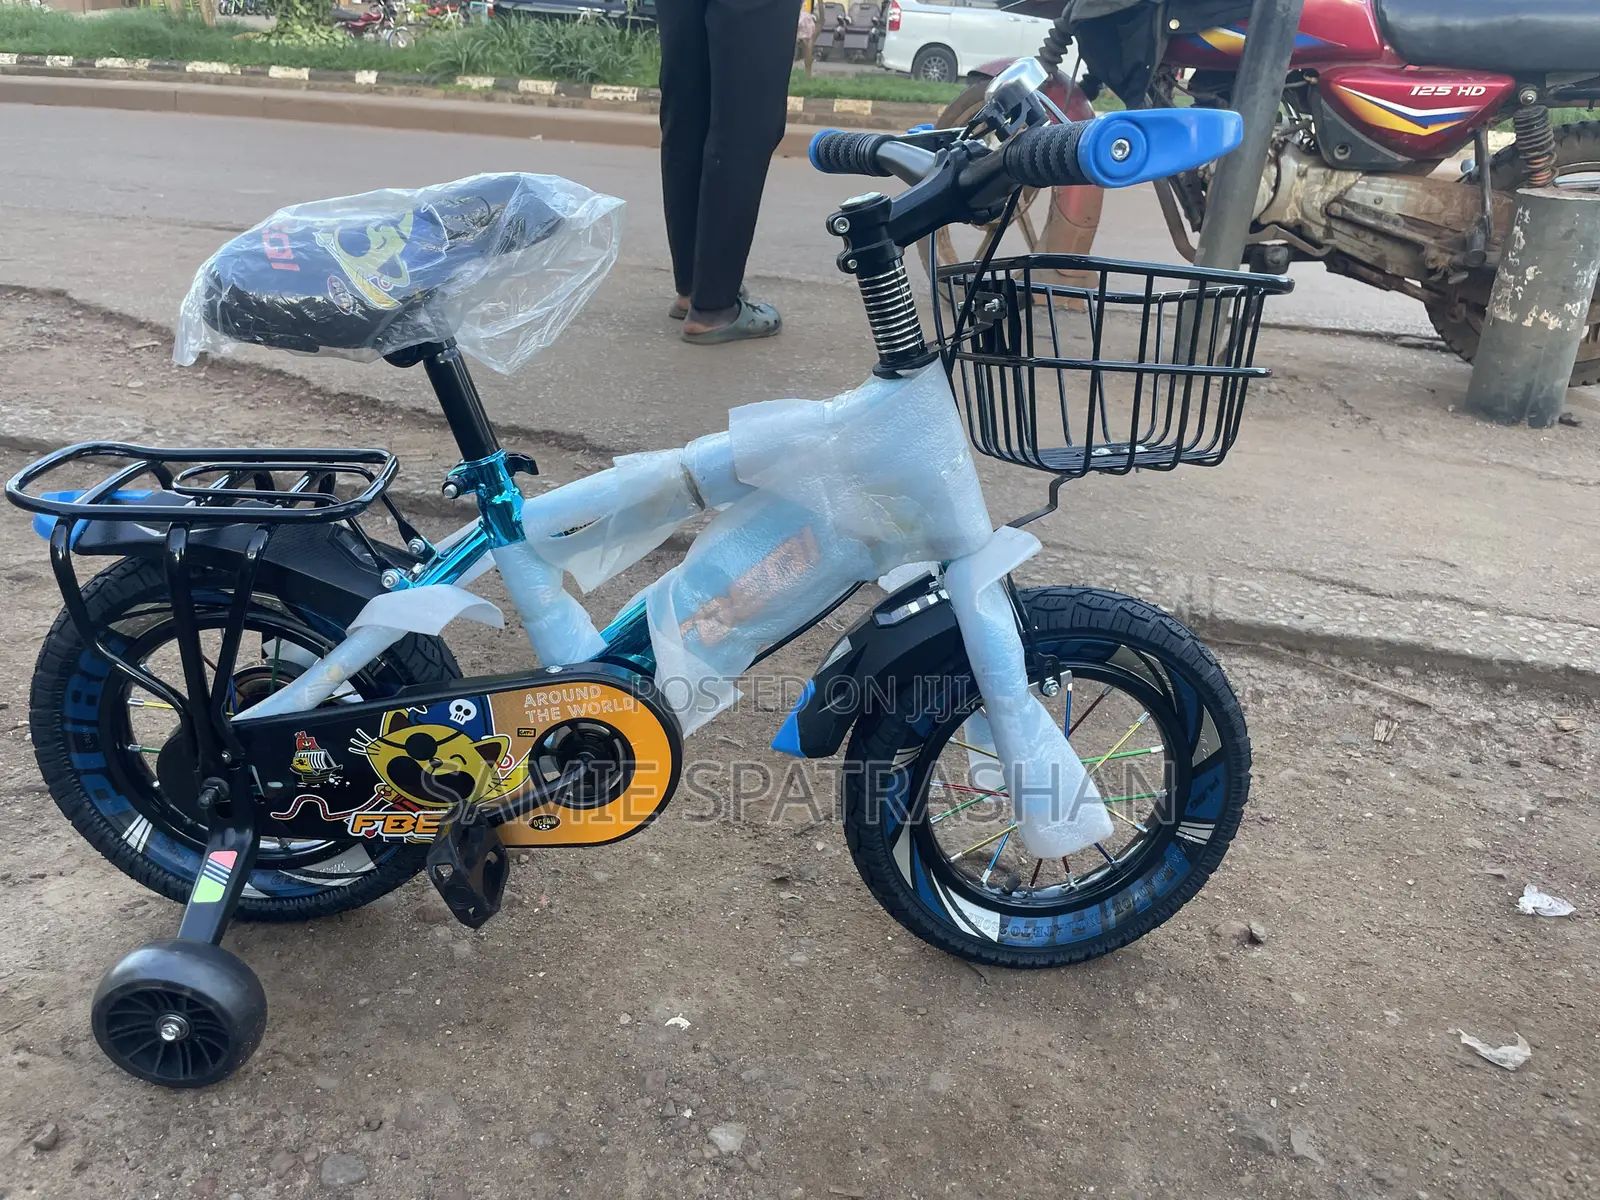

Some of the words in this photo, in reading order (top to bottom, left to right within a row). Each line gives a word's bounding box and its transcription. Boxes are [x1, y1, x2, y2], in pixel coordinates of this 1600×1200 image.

[1410, 86, 1453, 96] 125
[1457, 86, 1486, 96] HD
[524, 686, 601, 708] AROUND
[525, 707, 561, 723] THE
[567, 697, 634, 718] WORLD
[533, 817, 556, 828] OCEAN
